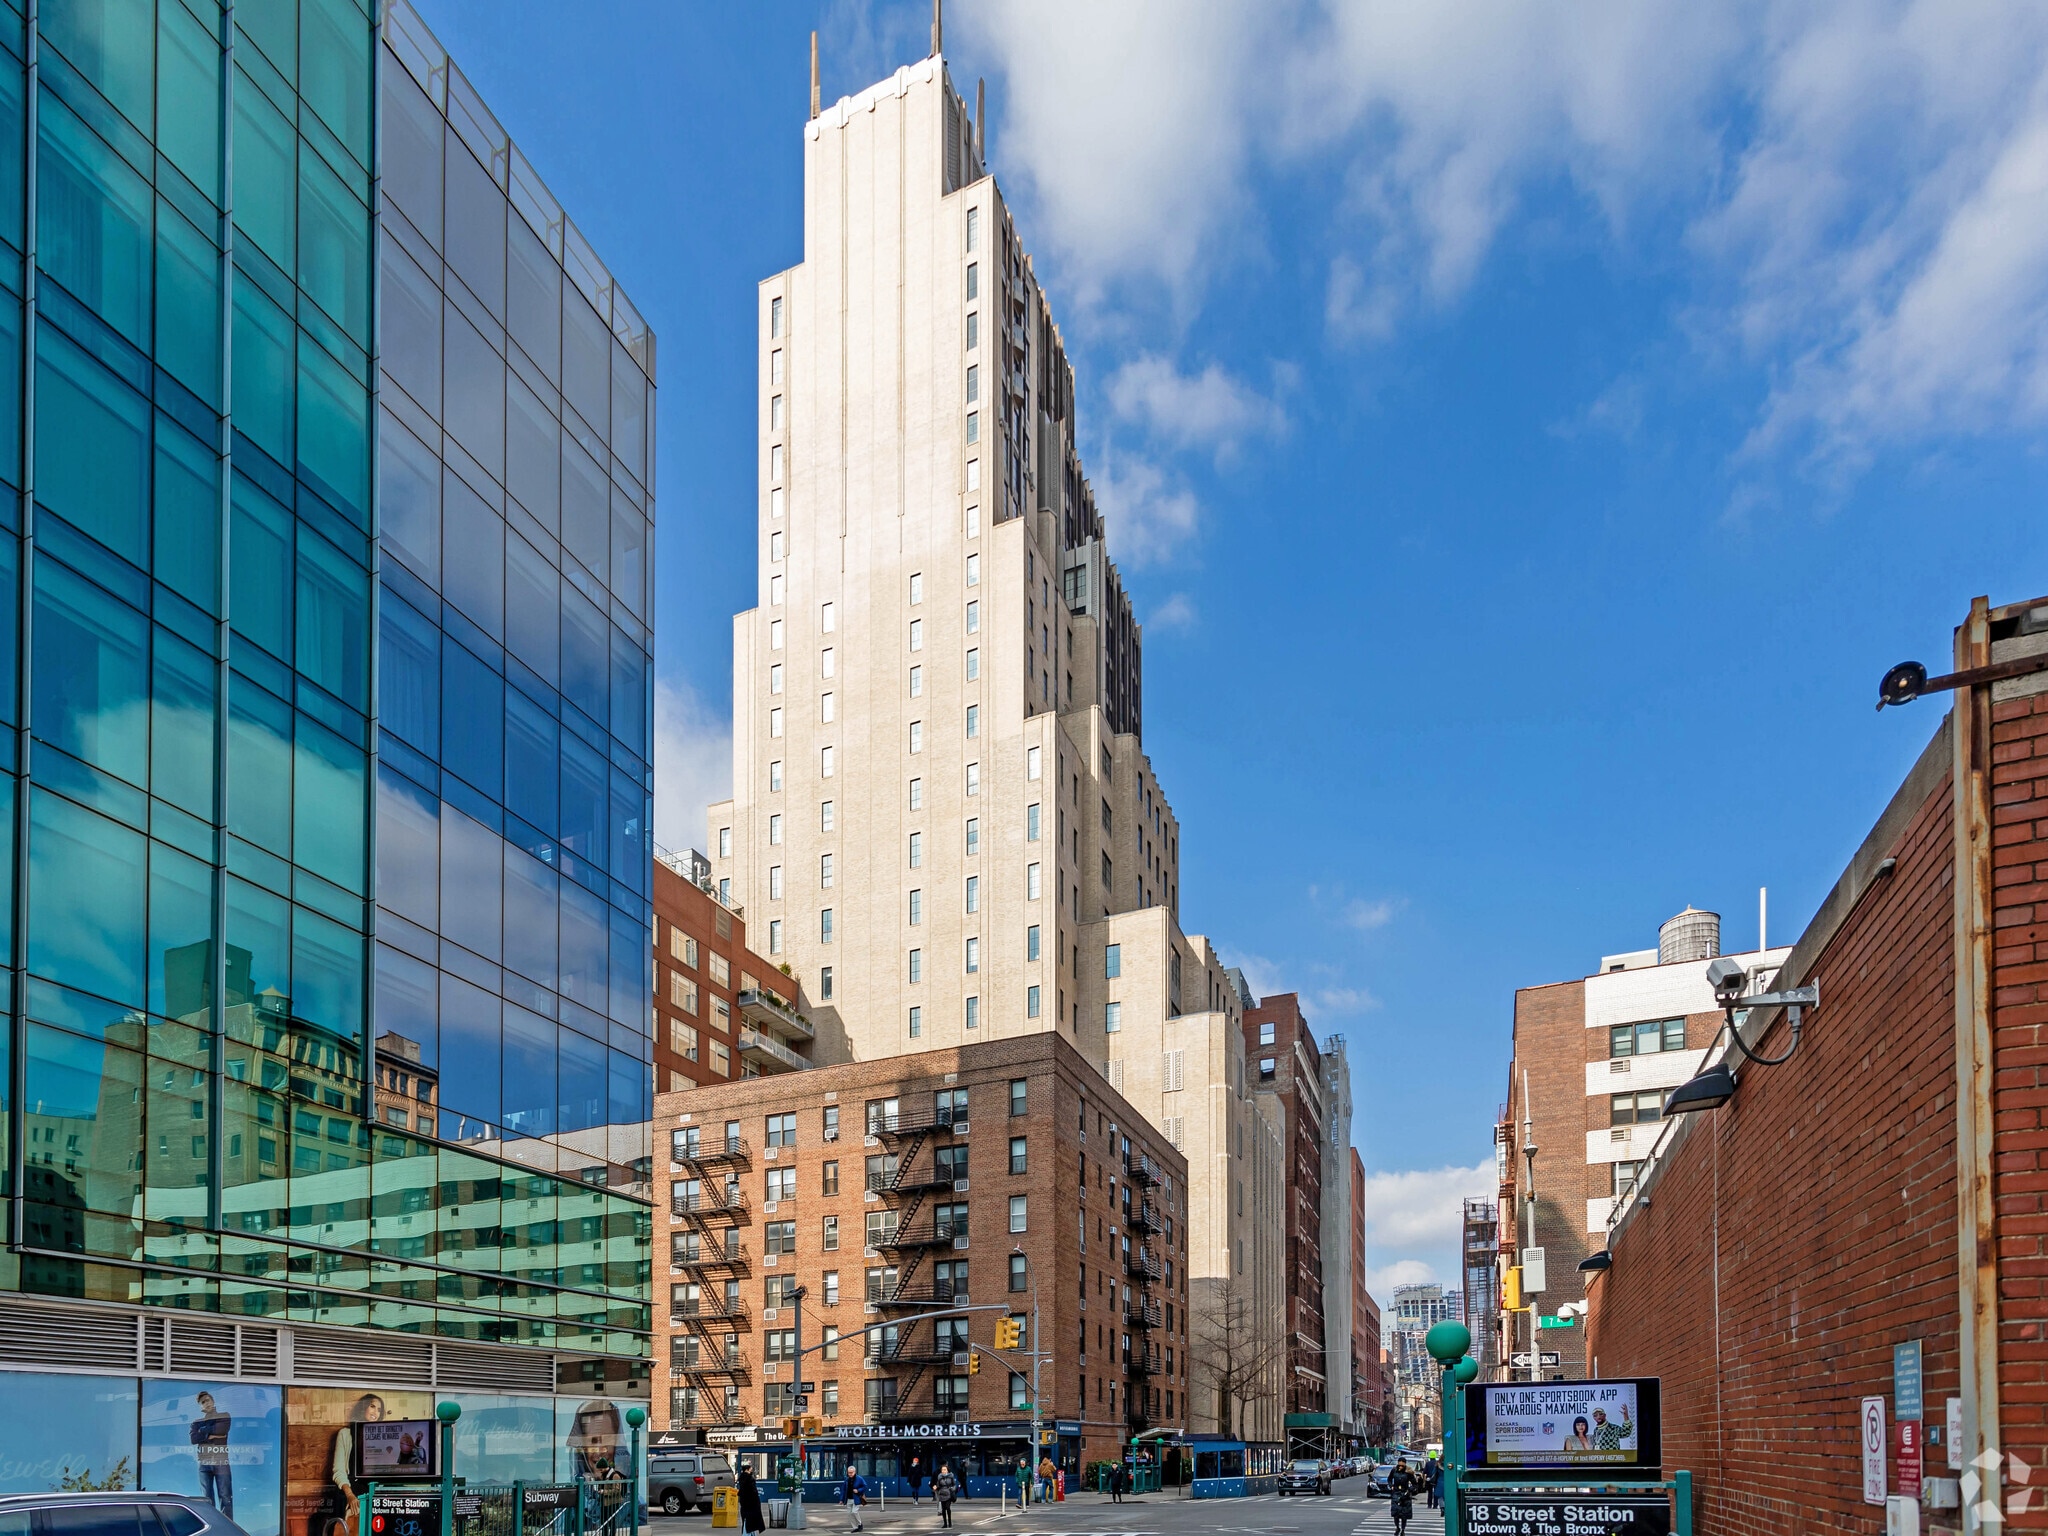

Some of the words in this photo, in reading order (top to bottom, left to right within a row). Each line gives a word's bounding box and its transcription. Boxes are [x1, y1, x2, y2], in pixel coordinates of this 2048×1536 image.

[1549, 1317, 1553, 1327] 7
[1495, 1392, 1516, 1404] ONLY
[1520, 1391, 1536, 1403] ONE
[1540, 1390, 1596, 1403] SPORTSBOOK
[1600, 1389, 1618, 1401] APP
[1546, 1402, 1588, 1415] MAXIMUS
[764, 1432, 777, 1440] The
[1495, 1426, 1535, 1434] SPORTSBOOK
[207, 1446, 255, 1454] POROWSKI
[1869, 1458, 1881, 1475] FIRE
[373, 1499, 380, 1507] 18
[382, 1499, 403, 1507] Street
[405, 1498, 430, 1508] Station
[525, 1491, 560, 1504] Subway
[1468, 1505, 1489, 1521] 18
[1497, 1505, 1555, 1521] Street
[1563, 1505, 1634, 1522] Station
[1468, 1523, 1516, 1535] Uptown
[1521, 1523, 1531, 1534] &
[1538, 1523, 1561, 1534] The
[1566, 1523, 1605, 1534] Bronx
